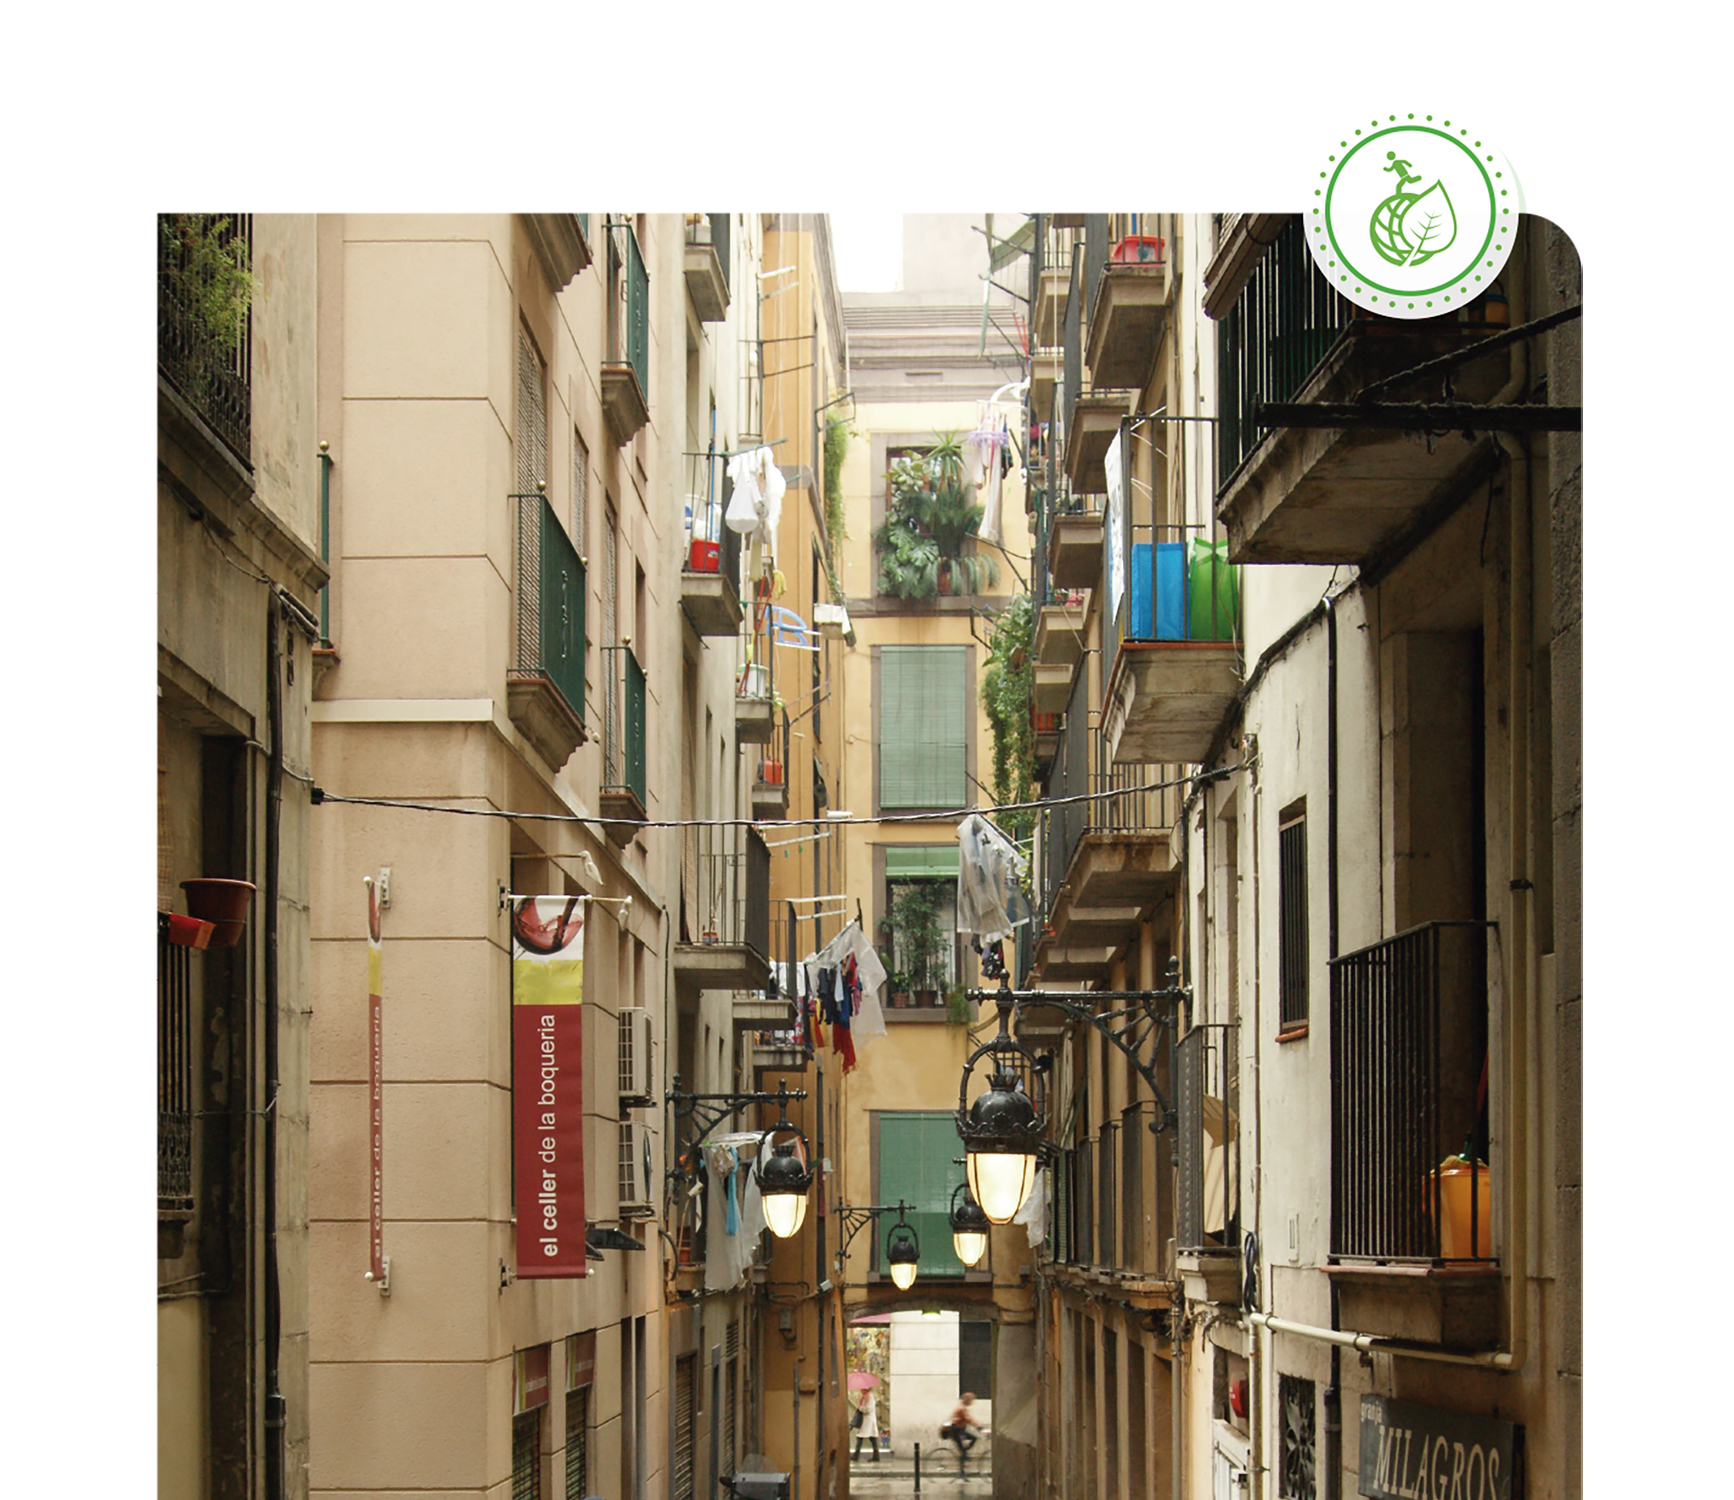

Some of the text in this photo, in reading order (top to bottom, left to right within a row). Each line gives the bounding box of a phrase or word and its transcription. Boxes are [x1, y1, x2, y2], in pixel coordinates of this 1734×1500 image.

[373, 1005, 381, 1101] boqueria
[373, 1107, 380, 1126] la
[374, 1133, 380, 1160] de
[537, 1014, 559, 1257] el celler de la boqueria
[374, 1237, 381, 1257] el
